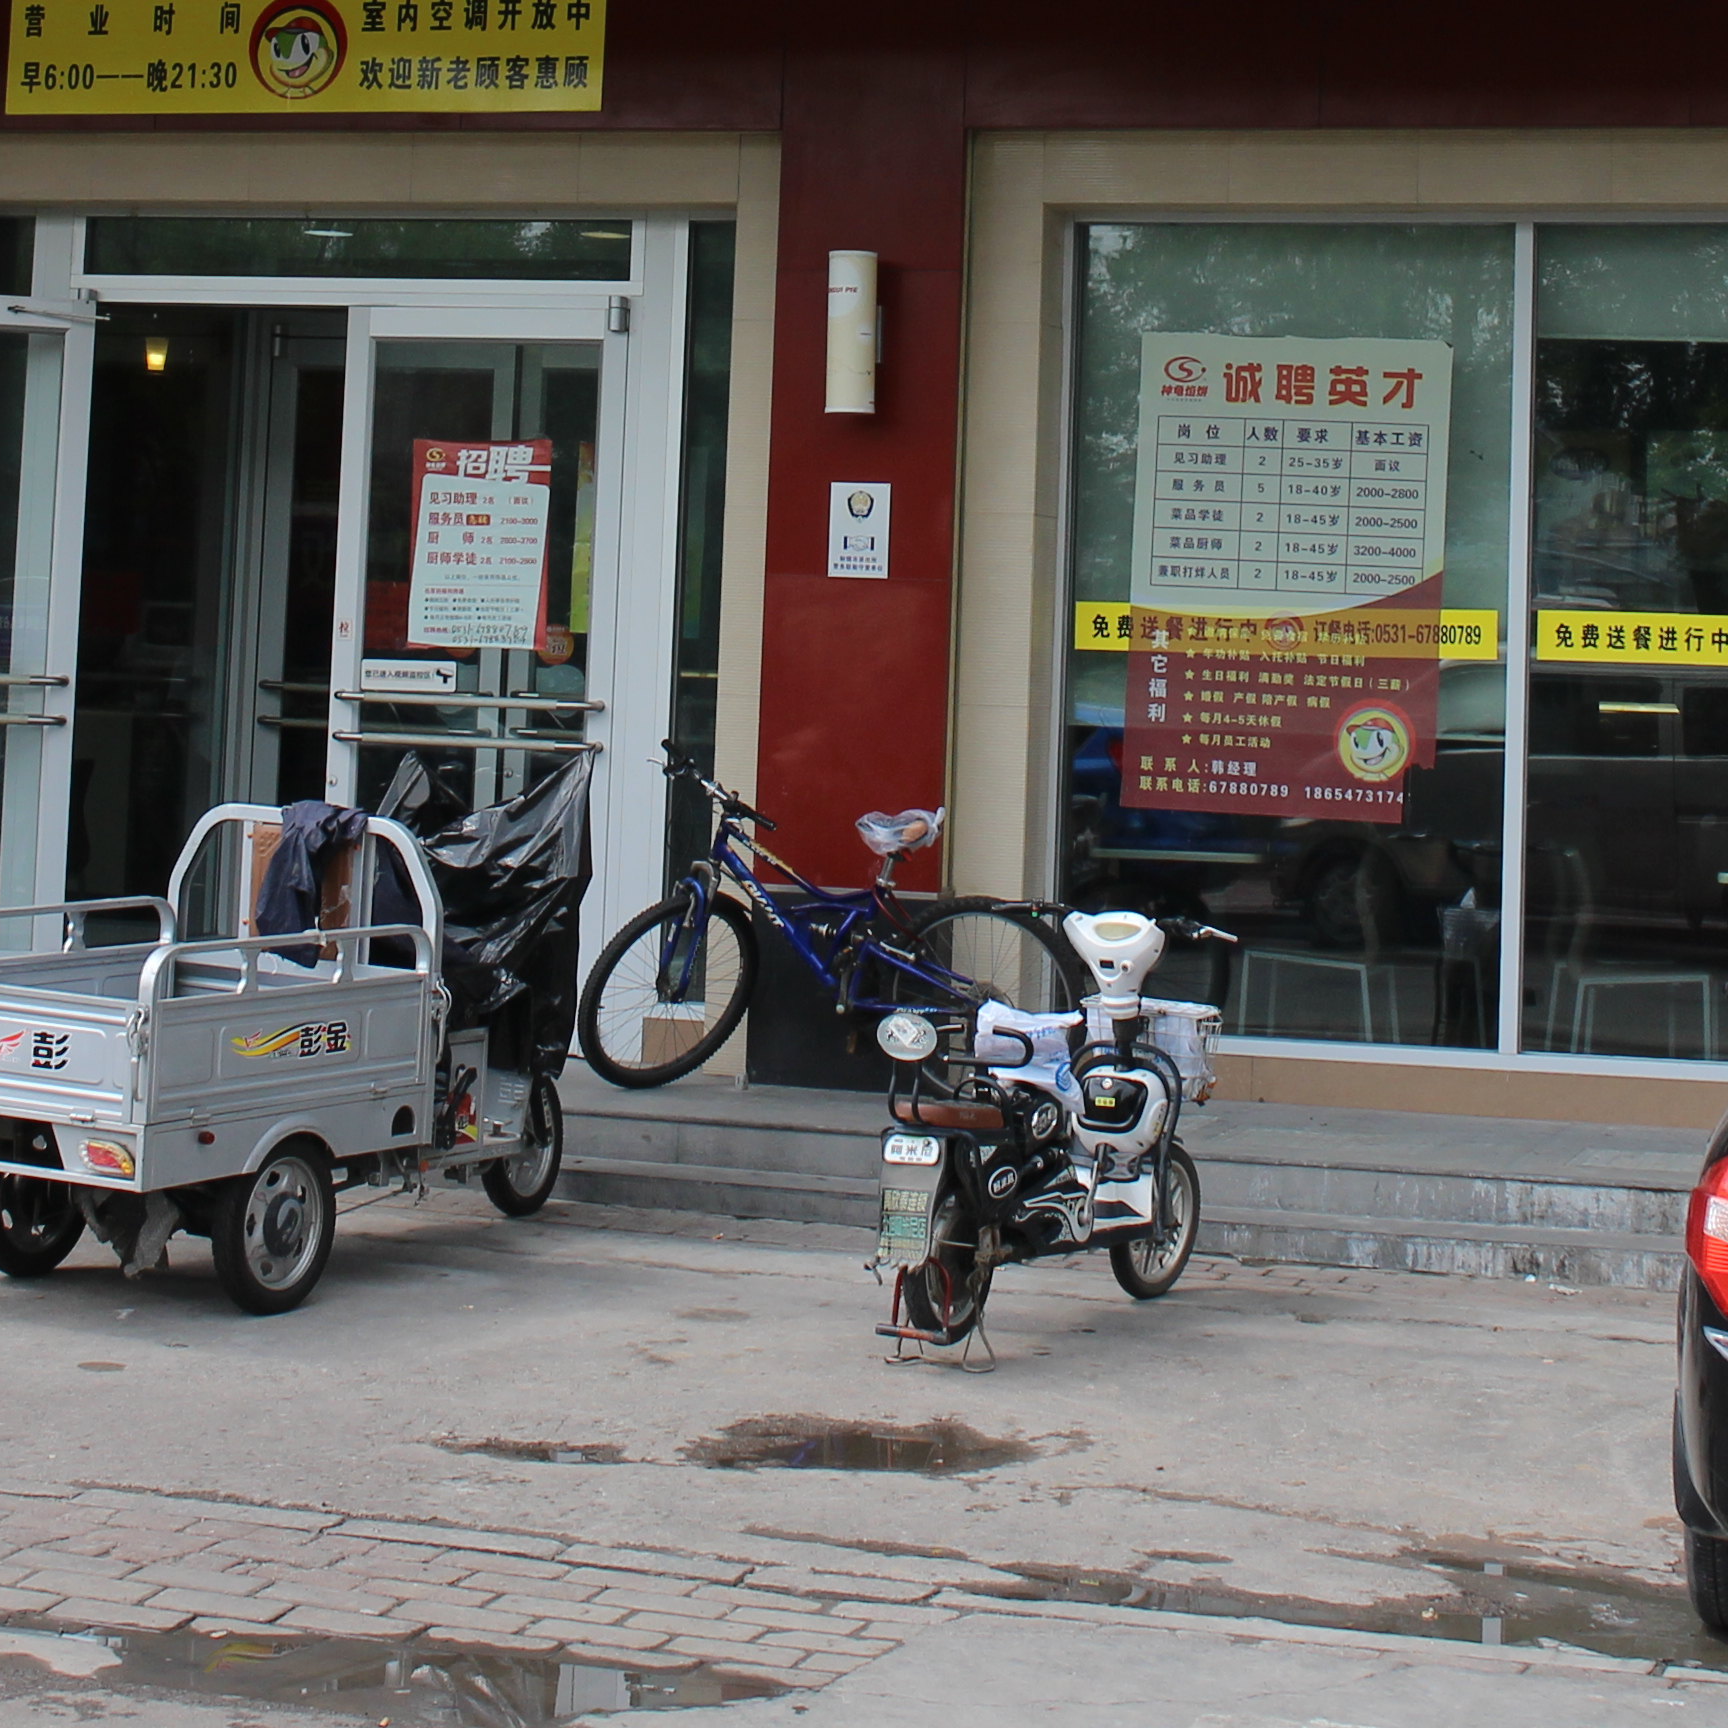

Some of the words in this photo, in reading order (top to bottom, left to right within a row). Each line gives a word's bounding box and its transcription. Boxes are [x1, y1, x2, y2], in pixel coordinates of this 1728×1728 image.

[24, 1, 242, 38] 营业时间
[358, 54, 589, 91] 欢迎新老顾客惠顾
[1223, 362, 1423, 409] 诚聘英才
[1177, 423, 1221, 440] 岗位
[1246, 425, 1279, 442] 人数
[1296, 427, 1330, 443] 要求
[1355, 429, 1423, 448] 基本工资
[456, 445, 552, 483] 招聘
[1173, 452, 1227, 466] 见习助理
[1258, 455, 1266, 466] 2
[1288, 456, 1344, 470] 25-35岁
[1374, 458, 1401, 472] 面议
[429, 491, 478, 505] 见习助理
[1172, 479, 1226, 493] 服务员
[1257, 483, 1265, 493] 5
[1287, 484, 1342, 497] 18-40岁
[1356, 486, 1419, 500] 2000-2800
[428, 512, 465, 526] 服务员
[1171, 508, 1225, 522] 菜品学徒
[1256, 512, 1264, 523] 2
[1286, 513, 1341, 527] 18-45岁
[1355, 515, 1418, 530] 2000-2500
[427, 551, 477, 566] 厨师学徒
[1255, 541, 1262, 552] 2
[1285, 542, 1339, 556] 18-45岁
[1353, 544, 1416, 558] 3200-4000
[1254, 568, 1262, 579] 2
[1284, 570, 1338, 583] 18-45岁
[1318, 653, 1365, 667] 节日福利
[1148, 630, 1170, 723] 其它福利
[1202, 669, 1250, 683] 生日福利
[1199, 734, 1271, 749] 每月员工活动
